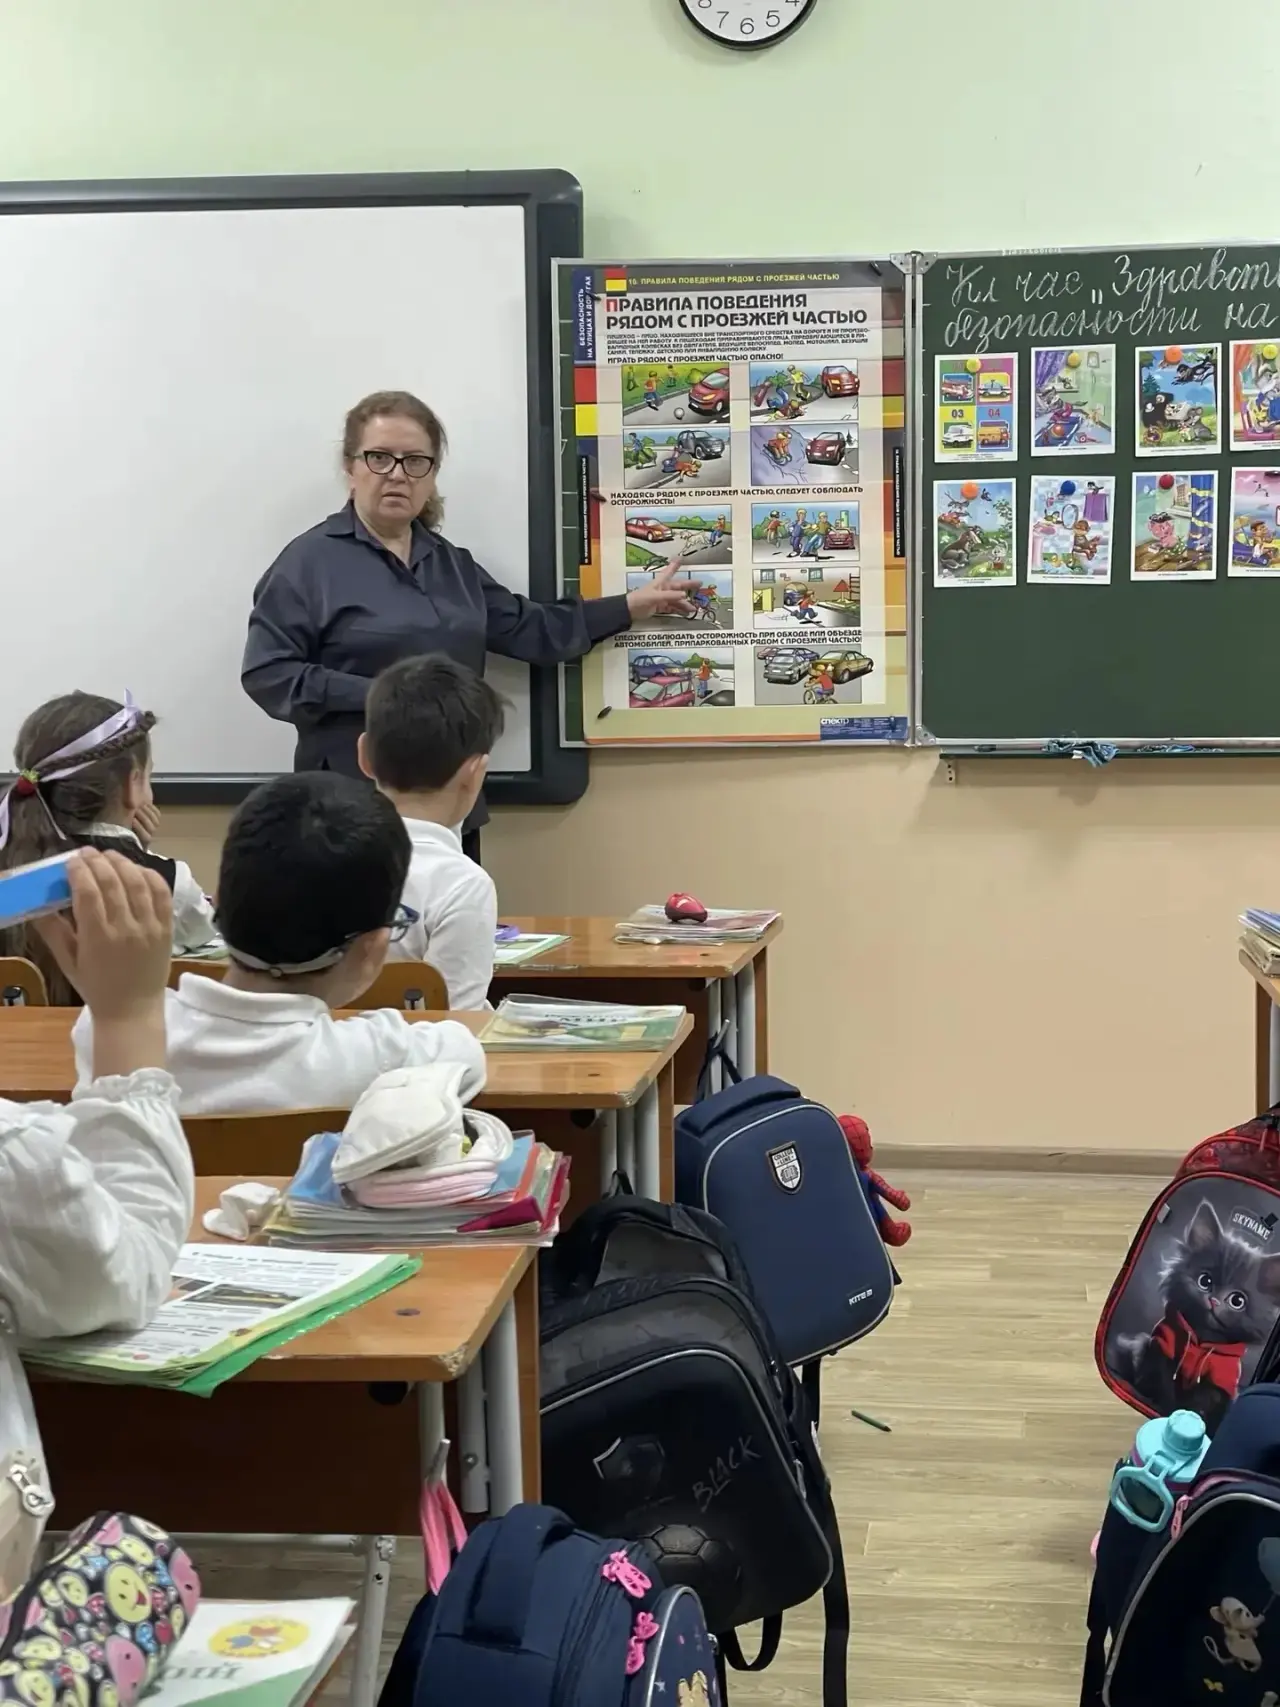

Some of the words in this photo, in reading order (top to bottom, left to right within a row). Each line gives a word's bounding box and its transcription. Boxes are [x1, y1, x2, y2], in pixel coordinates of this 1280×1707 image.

[716, 11, 729, 29] 7
[740, 17, 755, 35] 6
[765, 10, 780, 27] 5
[641, 277, 677, 285] ПРАВИЛА
[679, 276, 725, 284] ПОВЕДЕНИЯ
[727, 275, 754, 283] РЯДОМ
[763, 274, 805, 282] ПРОЕЗЖЕЙ
[807, 273, 840, 281] ЧАСТЬЮ
[1015, 271, 1083, 302] час
[606, 297, 693, 312] ПРАВИЛА
[697, 293, 807, 311] ПОВЕДЕНИЯ
[578, 288, 586, 346] БЕЗОПАСНОСТЬ
[606, 315, 673, 330] РЯДОМ
[677, 315, 687, 328] С
[691, 310, 789, 328] ПРОЕЗЖЕЙ
[792, 309, 868, 325] ЧАСТЬЮ
[944, 306, 1202, 354] безопасности
[1224, 302, 1280, 330] на
[587, 347, 593, 358] НА
[749, 353, 784, 361] ОПАСНО!
[951, 409, 964, 419] 03
[987, 408, 1001, 419] 04
[610, 491, 655, 499] НАХОДЯСЬ
[657, 490, 686, 498] РЯДОМ
[695, 489, 738, 497] ПРОЕЗЖЕЙ
[775, 487, 810, 495] СЛЕДУЕТ
[812, 486, 864, 495] СОБЛЮДАТЬ
[611, 498, 675, 506] ОСТОРОЖНОСТЬ!
[647, 633, 695, 641] СОБЛЮДАТЬ
[827, 629, 862, 637] ОБЪЕЗДЕ
[674, 639, 749, 647] ПРИПАРКОВАННЫХ
[786, 637, 827, 645] ПРОЕЗЖЕЙ
[1232, 1212, 1270, 1241] SKYNAME
[692, 1435, 762, 1513] BLACK
